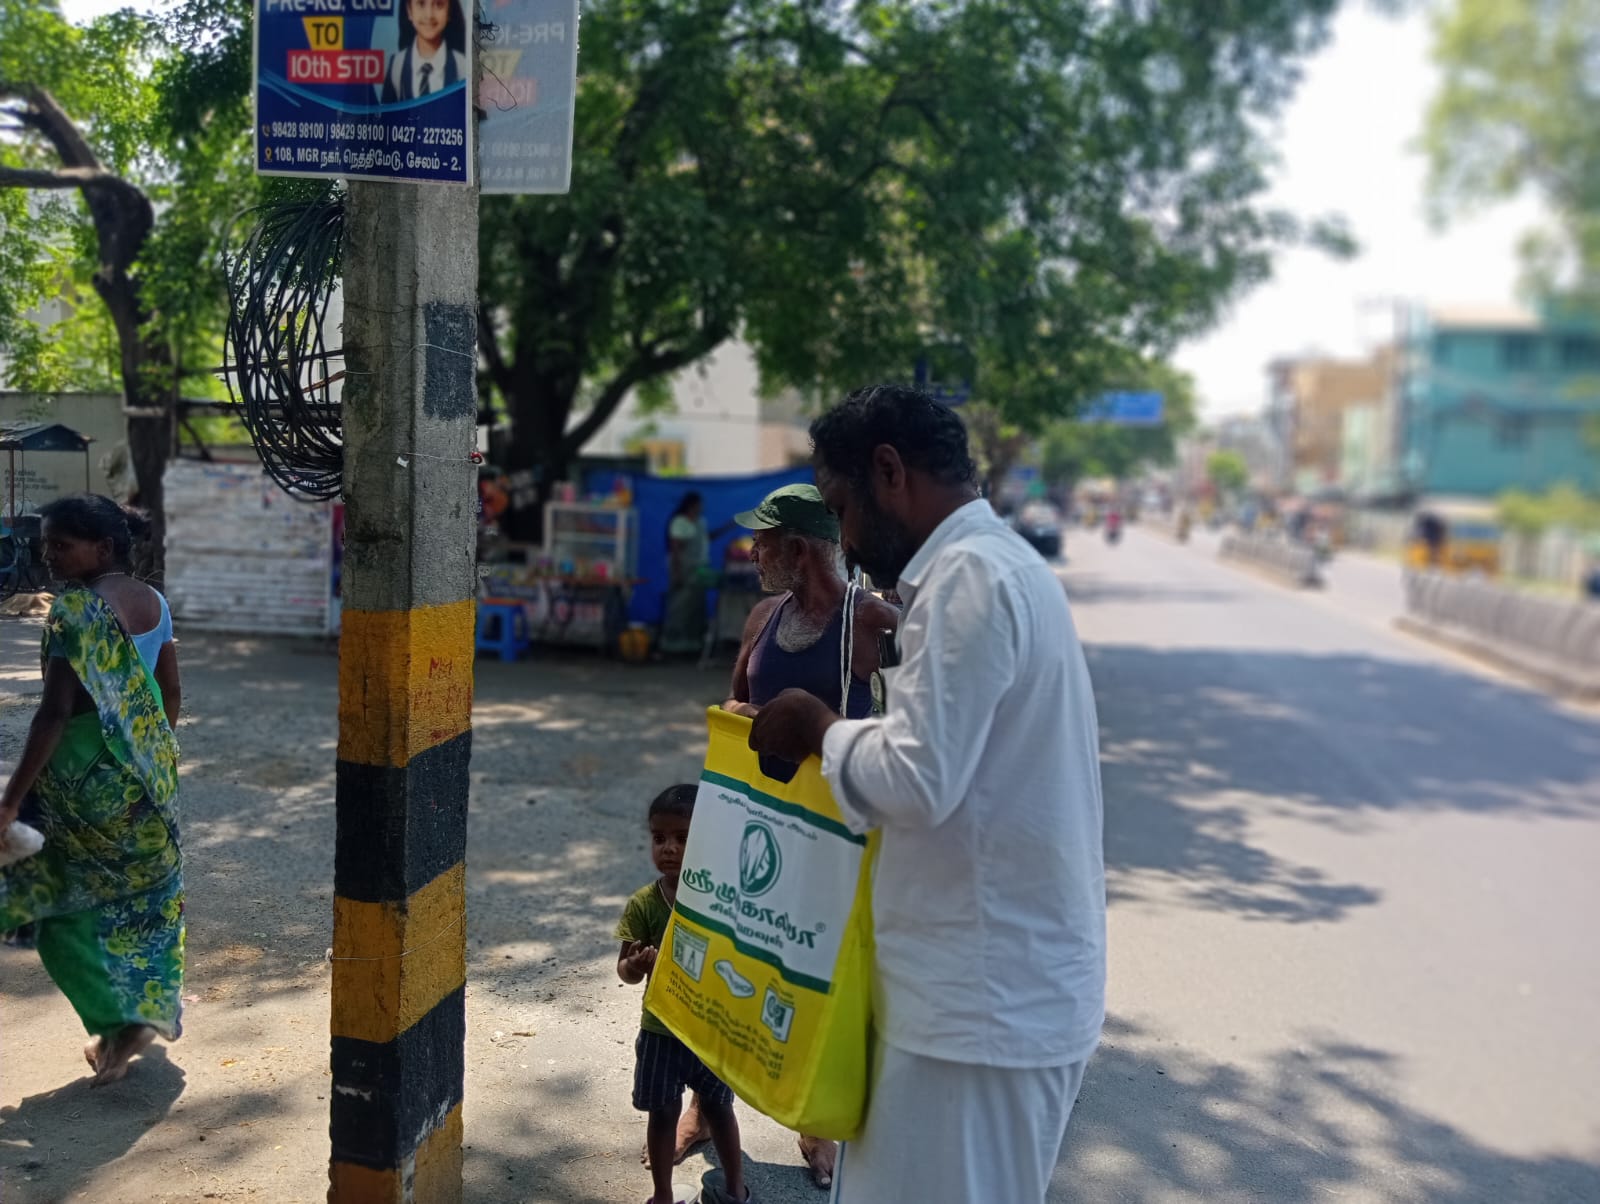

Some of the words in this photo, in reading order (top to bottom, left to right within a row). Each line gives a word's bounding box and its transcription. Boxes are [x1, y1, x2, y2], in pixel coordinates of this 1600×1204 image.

[312, 23, 340, 46] TO
[291, 55, 331, 78] 10th
[337, 55, 380, 79] STD
[272, 122, 297, 138] 98428
[299, 123, 324, 139] 98100
[330, 124, 355, 140] 98429
[357, 125, 384, 141] 98100
[392, 126, 414, 143] 0427
[423, 127, 463, 146] 2273256
[274, 147, 295, 164] 108,
[297, 148, 319, 163] MGR
[406, 151, 440, 171] சேலம்
